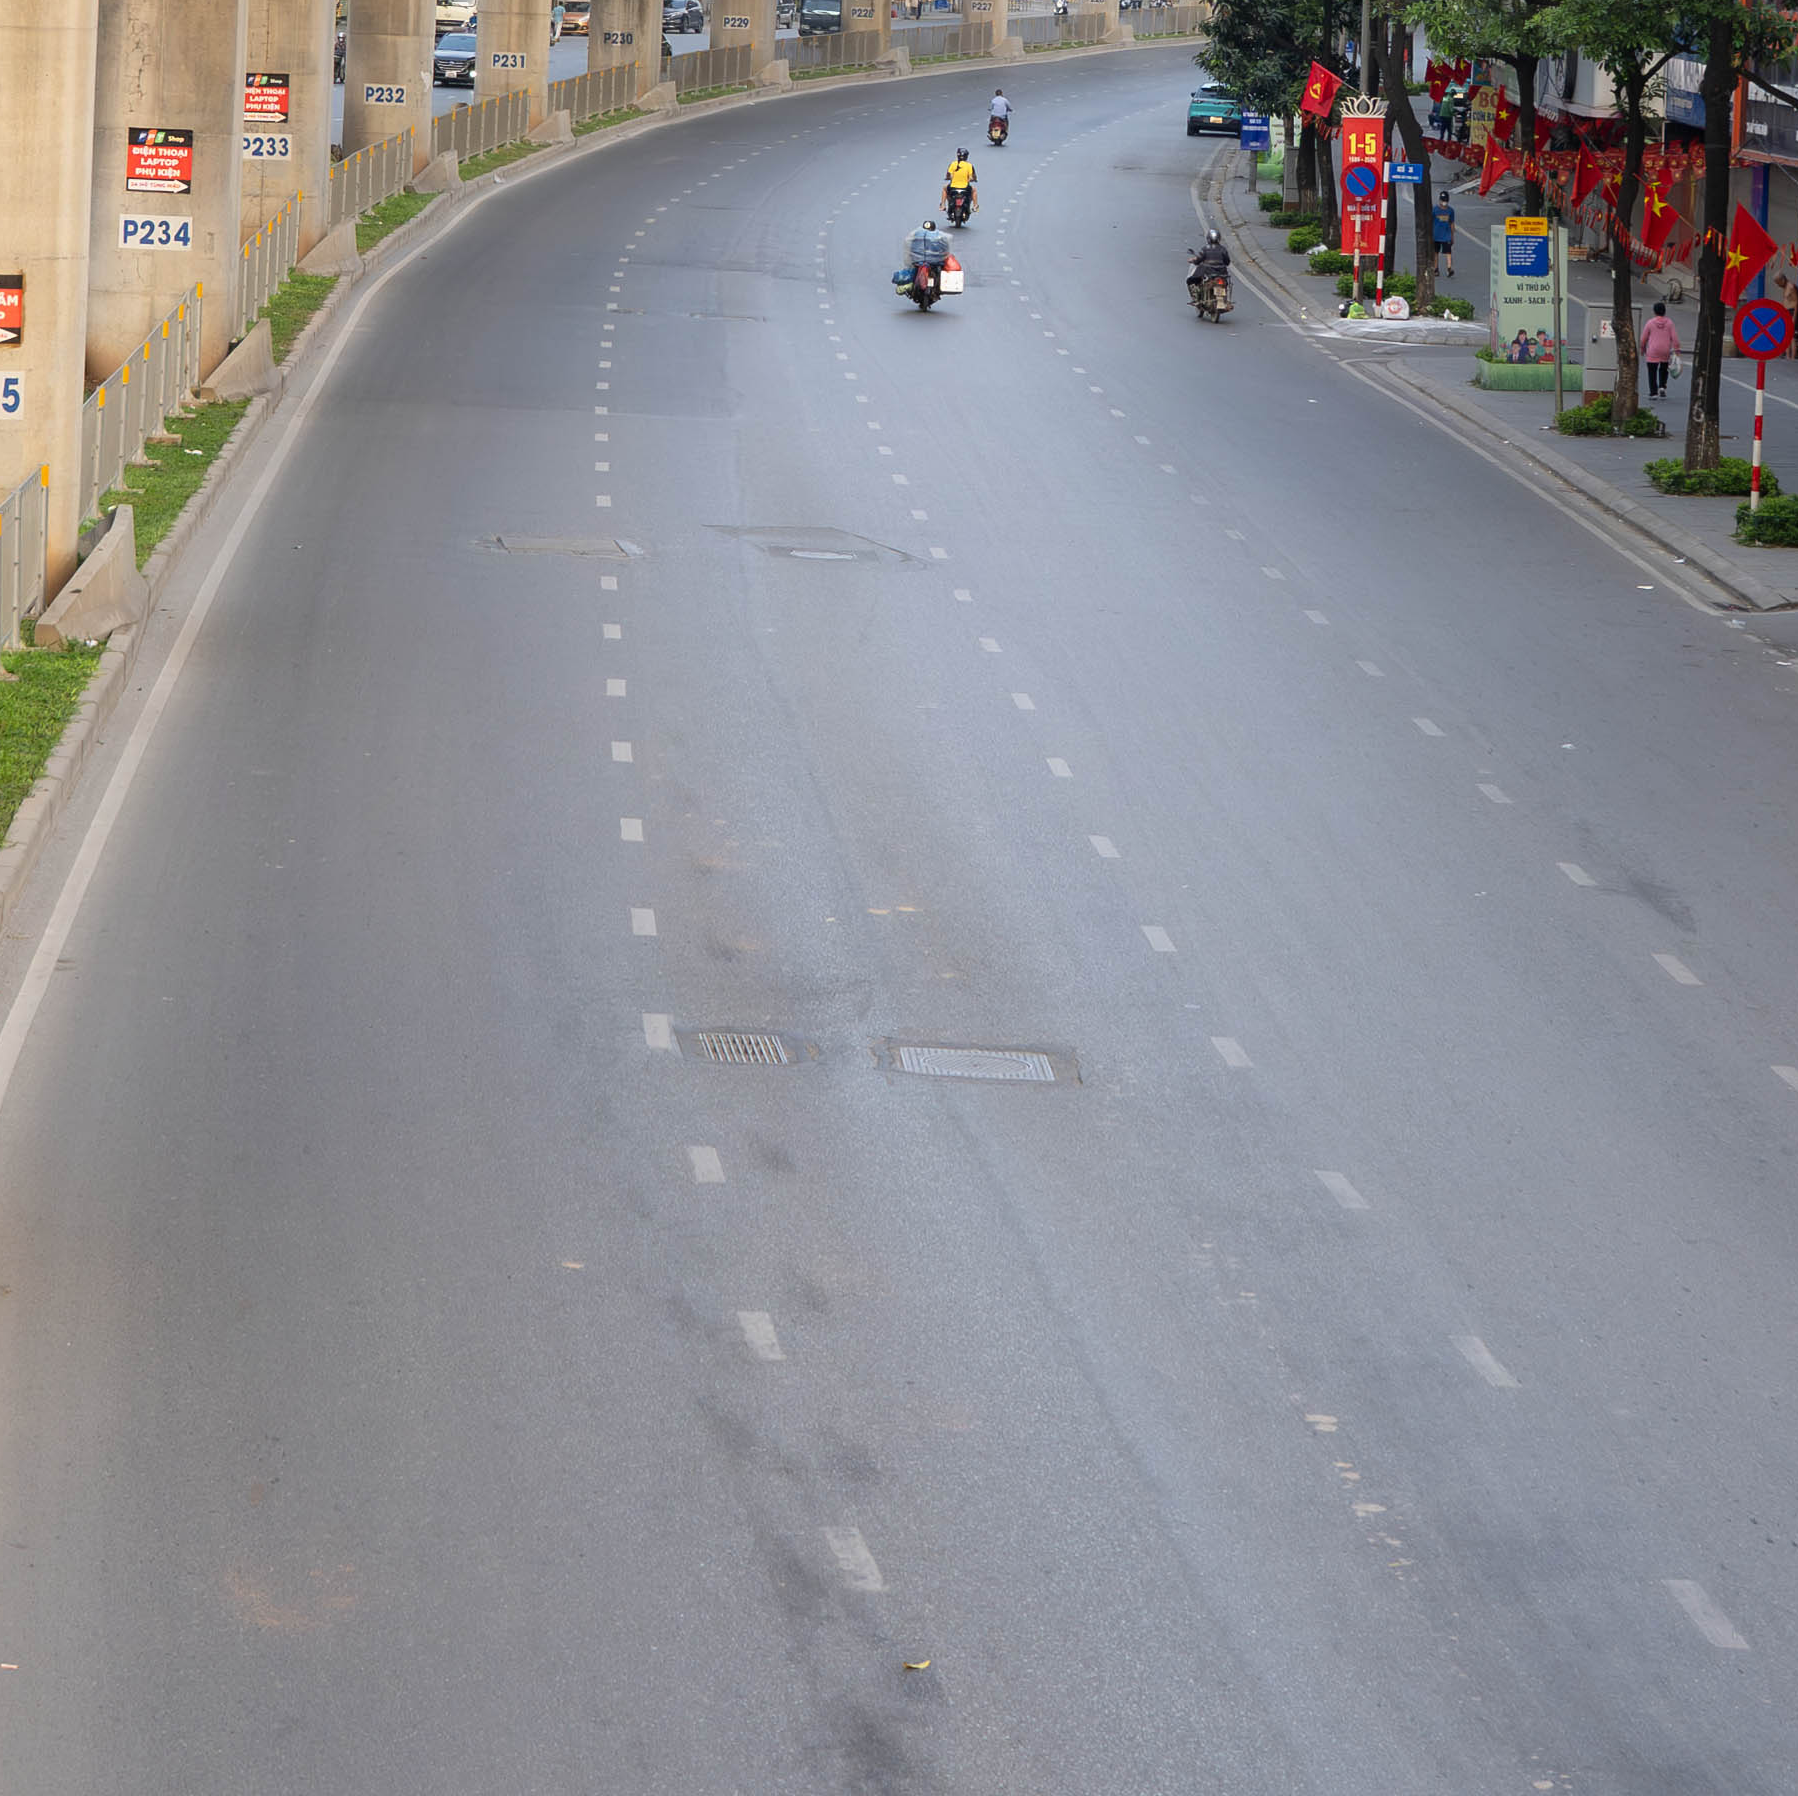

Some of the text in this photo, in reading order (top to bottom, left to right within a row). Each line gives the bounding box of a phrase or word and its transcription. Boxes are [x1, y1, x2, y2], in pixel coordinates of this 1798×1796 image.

[722, 15, 751, 30] P229
[603, 31, 634, 46] P230
[492, 53, 526, 69] P231
[249, 95, 279, 103] LAPTOP
[364, 85, 405, 104] P232
[1349, 133, 1376, 155] 1-5
[158, 148, 188, 159] THOẠI
[140, 158, 180, 167] LAPTOP
[123, 219, 190, 247] P234
[1503, 297, 1523, 305] XANH
